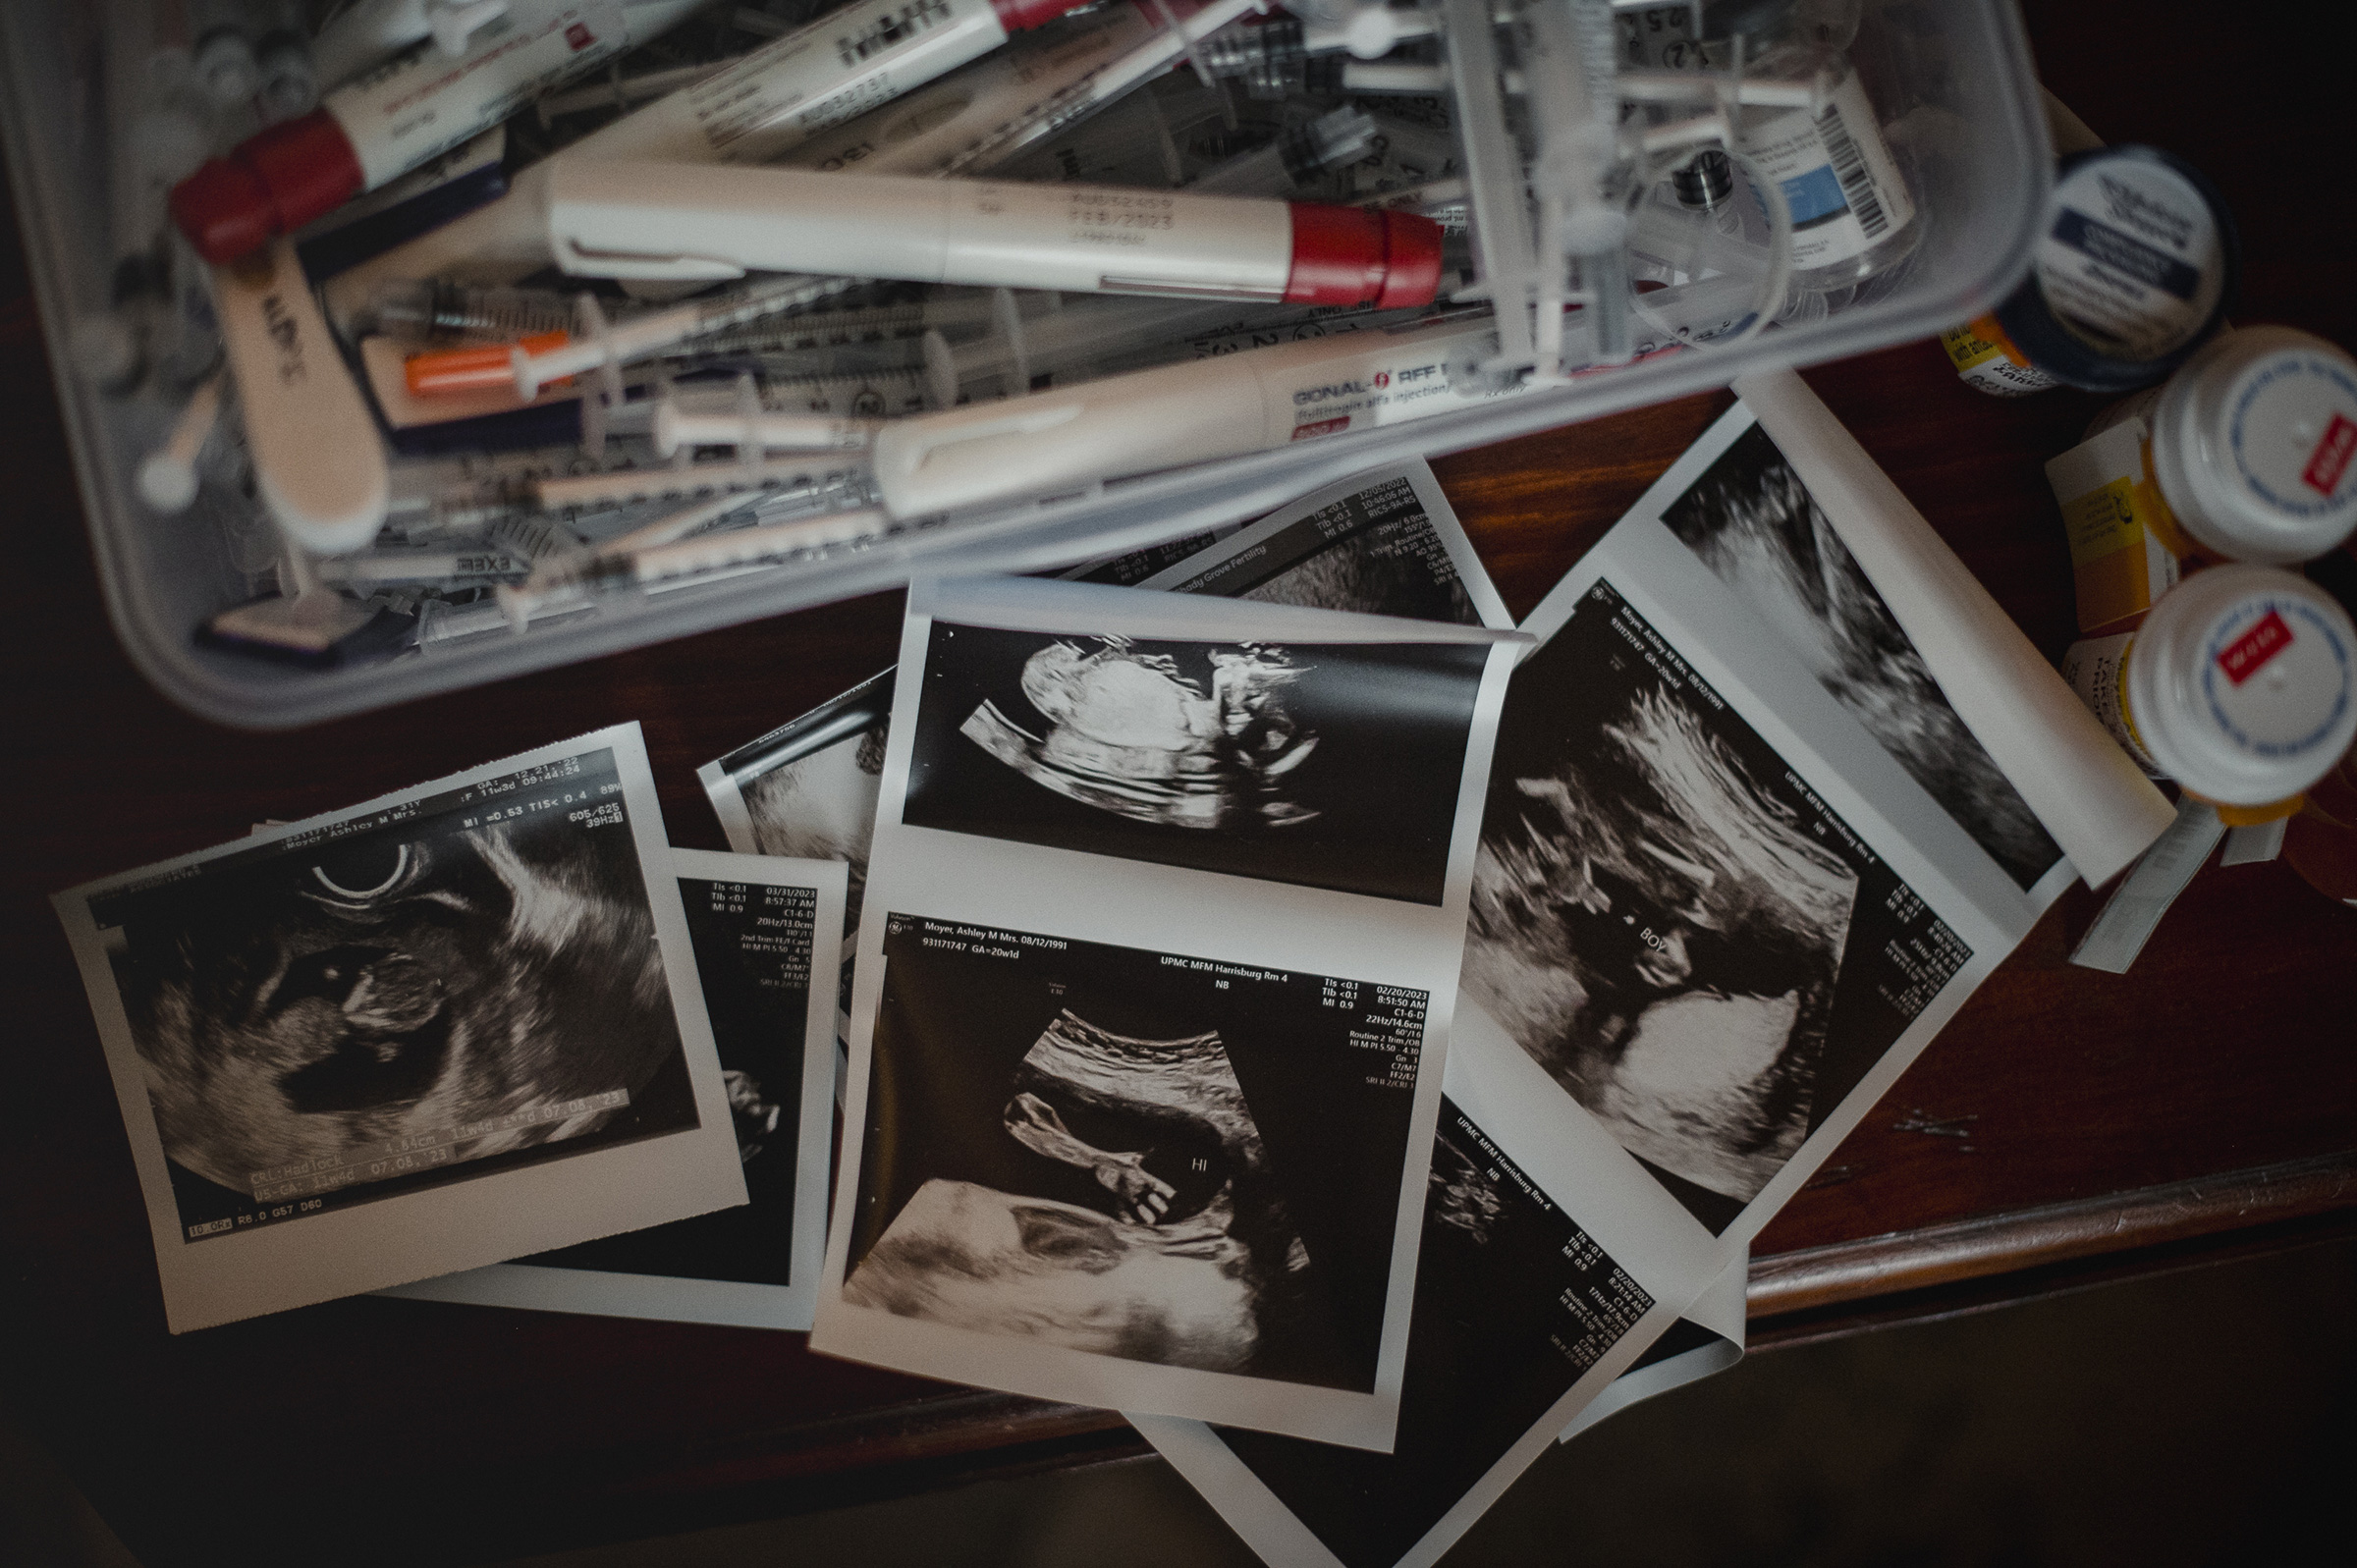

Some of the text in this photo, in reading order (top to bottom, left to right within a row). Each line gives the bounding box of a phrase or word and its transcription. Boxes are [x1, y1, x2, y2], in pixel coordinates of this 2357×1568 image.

[1069, 208, 1175, 230] FEB/2023
[1952, 342, 1972, 361] with
[1357, 476, 1406, 501] 12/05/2022
[1396, 485, 1411, 496] AM
[1331, 510, 1352, 522] <0.1
[1324, 520, 1353, 538] MI 0.6
[1204, 545, 1267, 582] Grove Fertility
[1664, 651, 1675, 662] M
[1672, 659, 1689, 677] Mrs.
[481, 765, 580, 798] 11w3d 09:44:24
[1784, 771, 1807, 795] UPMC
[1805, 791, 1825, 812] MFM
[378, 816, 389, 825] M
[394, 810, 422, 821] Mrs.
[464, 817, 478, 828] MI
[564, 790, 587, 803] 0.4
[569, 802, 620, 822] 605/625
[713, 883, 746, 893] TIs <0.1
[766, 887, 815, 898] 03/31/2023
[711, 892, 746, 903] TIb <0.1
[765, 896, 815, 908] 8:57:37 AM
[712, 902, 743, 914] MI 0.9
[784, 908, 814, 919] C1-6-D
[924, 921, 1069, 950] Moyer, Ashley M Mrs. 08/12/1991
[1640, 927, 1667, 951] BOY
[922, 937, 1019, 959] 931171747 GA=20w1d
[1949, 949, 1964, 965] AM
[1161, 956, 1188, 968] UPMC
[1190, 960, 1213, 971] MFM
[1215, 964, 1262, 980] Harrisburg
[1264, 971, 1279, 981] Rm
[1215, 980, 1230, 990] NB
[1325, 978, 1337, 987] TIs
[1322, 987, 1357, 1000] TIb <0.1
[1376, 986, 1427, 1000] 02/20/2023
[1322, 998, 1354, 1009] MI 0.9
[1378, 996, 1426, 1009] 8:51:50 AM
[1365, 1014, 1423, 1030] 22Hz/14.6cm
[1395, 1008, 1424, 1019] C1-6-D
[1349, 1030, 1379, 1041] Routine
[1391, 1061, 1417, 1071] C7/M7
[1396, 1054, 1406, 1062] Gn
[1192, 1158, 1207, 1171] HI
[1456, 1116, 1480, 1140] UPMC
[1478, 1137, 1499, 1158] MFM
[1496, 1155, 1532, 1194] Harrisburg
[1531, 1189, 1544, 1205] Rm
[249, 1155, 344, 1185] CRL:Hadlock
[1486, 1167, 1501, 1181] NB
[272, 1205, 294, 1217] G57
[300, 1199, 323, 1212] D60
[1567, 1236, 1597, 1266] TIb <0.1
[1576, 1230, 1604, 1258] TIs <0.1
[1562, 1245, 1588, 1271] MI 0.9
[1607, 1275, 1646, 1315] 8:21:14 AM
[1611, 1266, 1653, 1309] 02/20/2023
[1562, 1286, 1589, 1313] Routine
[1565, 1302, 1575, 1312] M
[1586, 1285, 1631, 1330] 17Hz/17.9cm
[1612, 1295, 1638, 1323] C1-6-D
